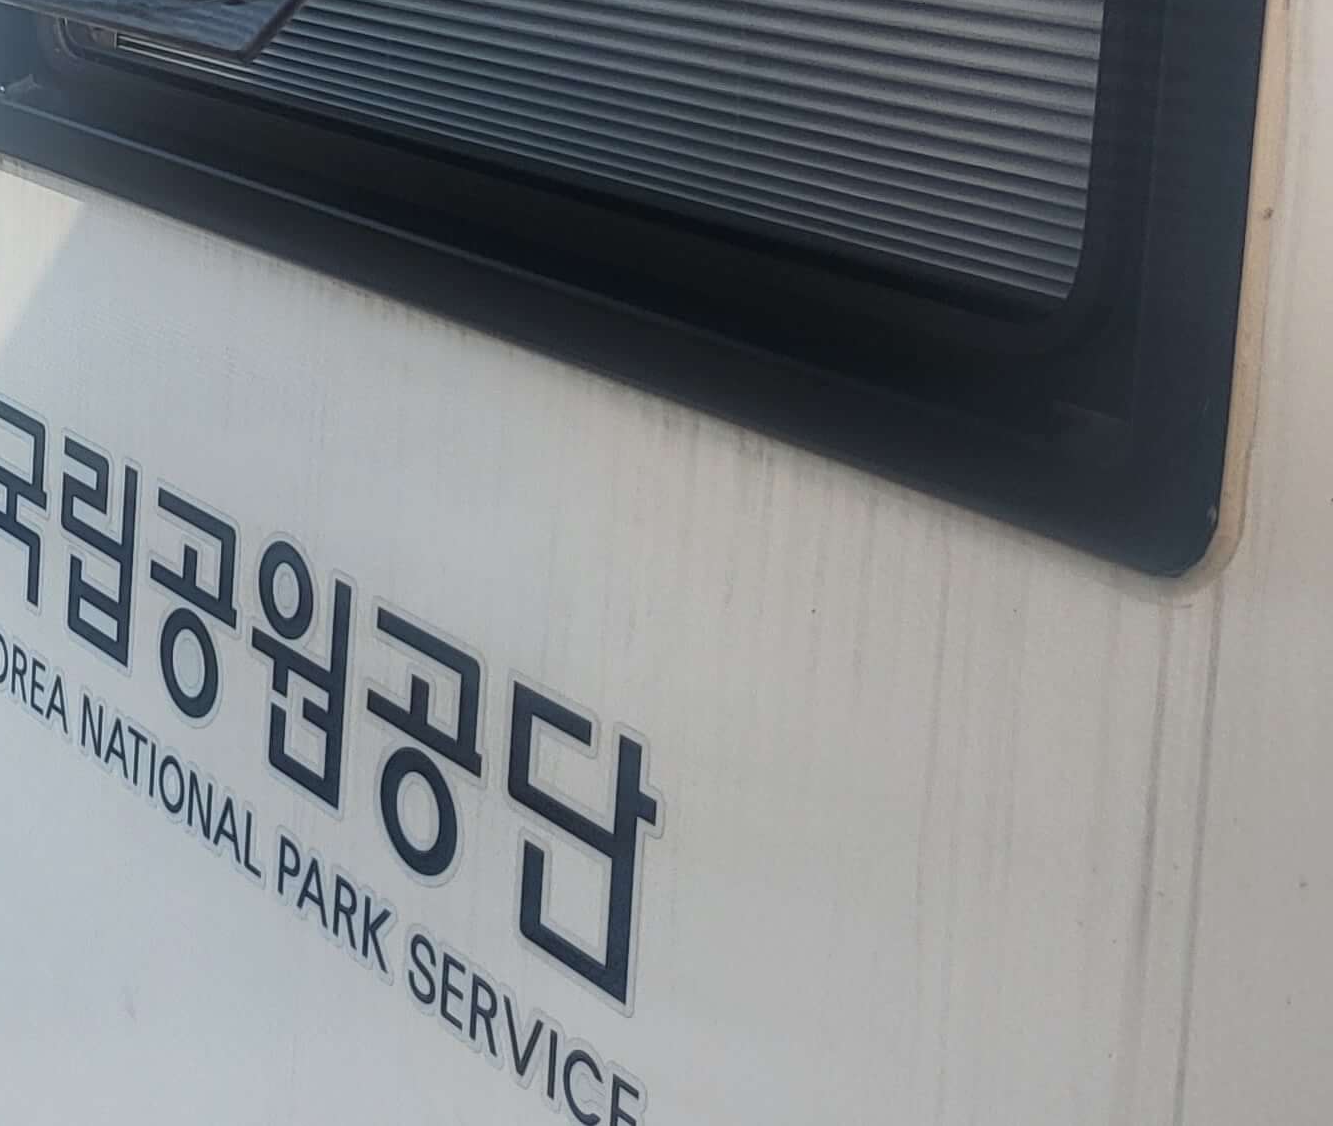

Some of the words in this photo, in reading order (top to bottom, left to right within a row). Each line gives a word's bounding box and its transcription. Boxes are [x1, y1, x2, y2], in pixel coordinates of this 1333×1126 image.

[79, 694, 262, 880] NATIONAL
[277, 835, 392, 973] PARK
[407, 932, 640, 1126] SERVICE
